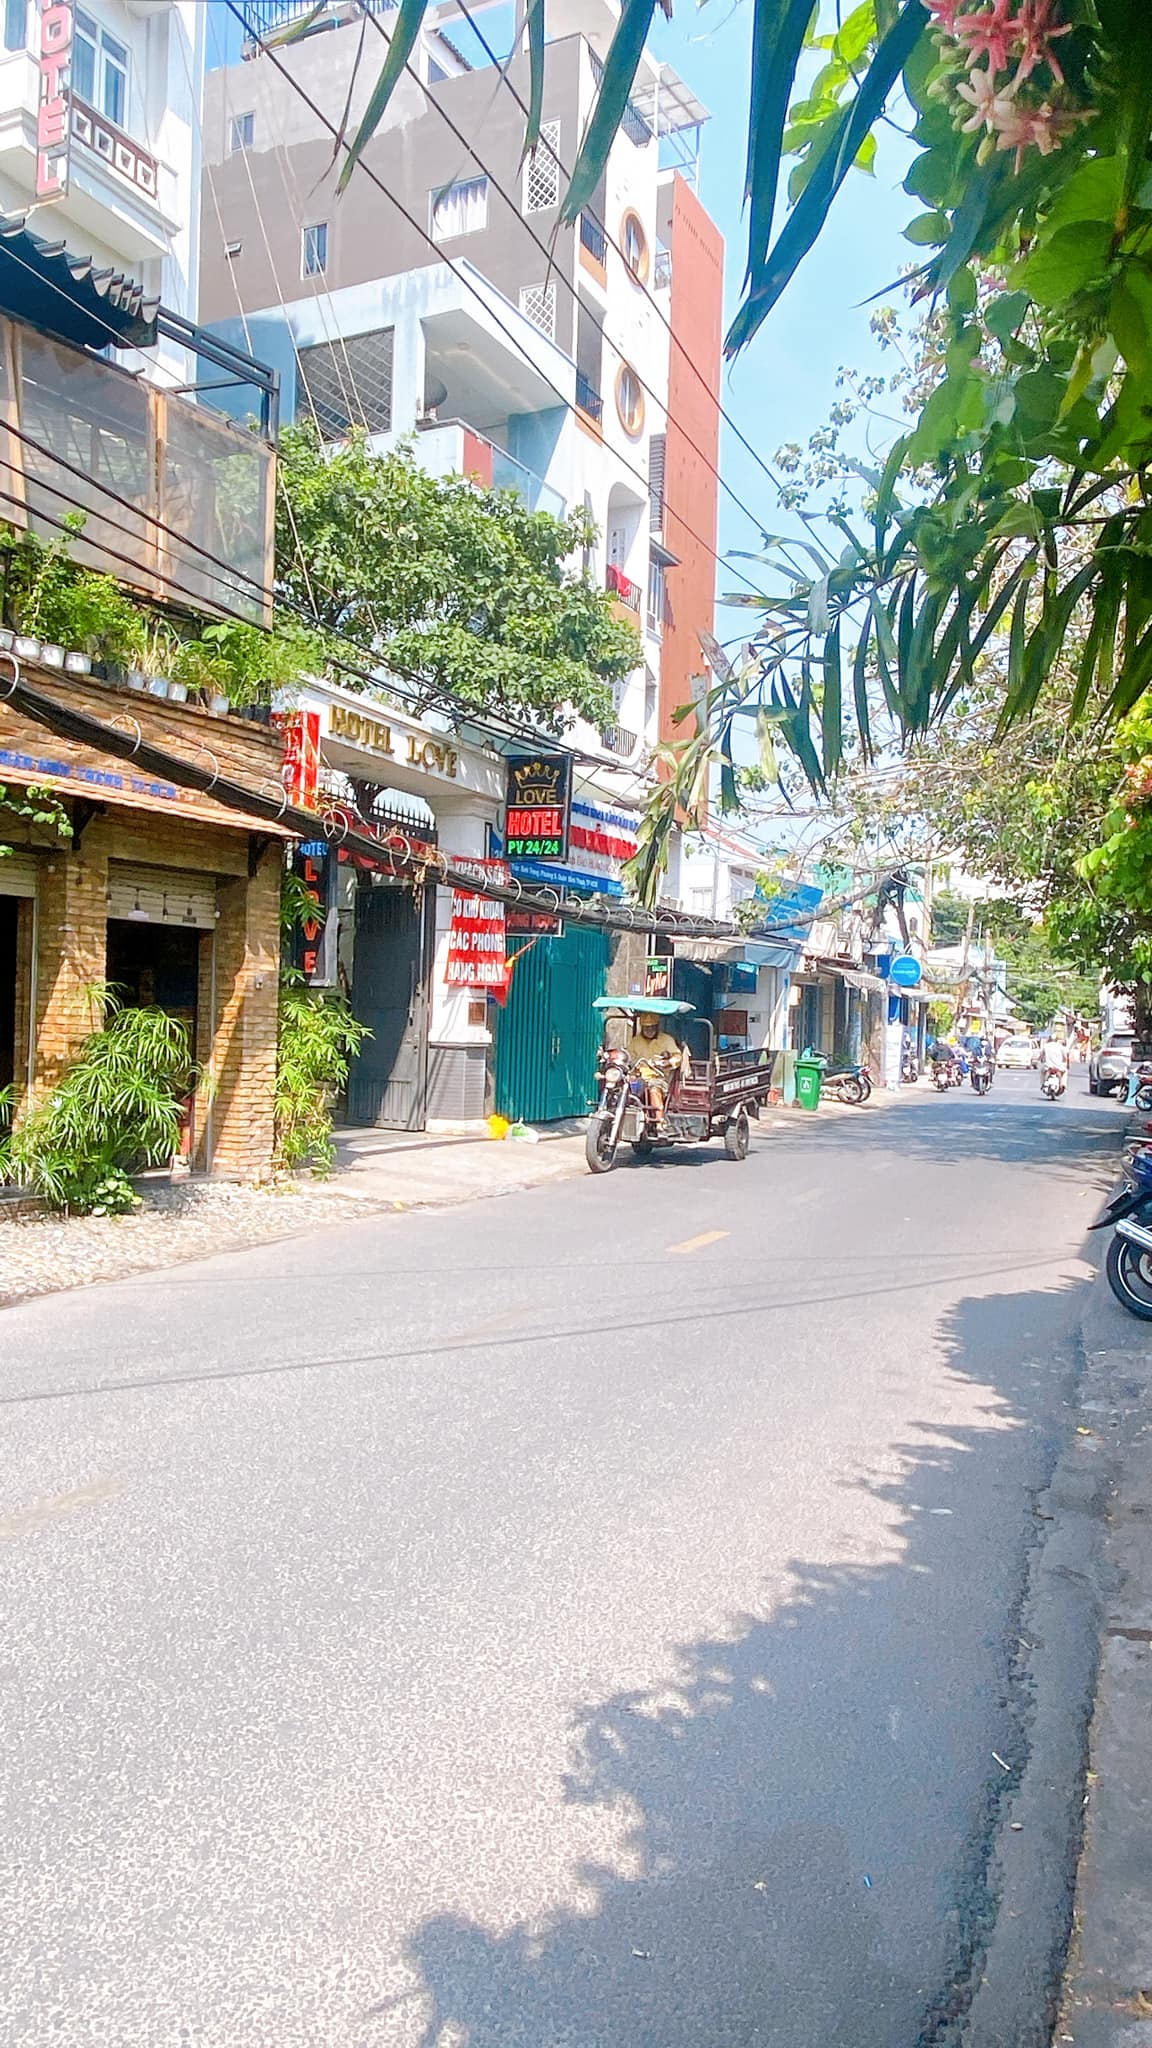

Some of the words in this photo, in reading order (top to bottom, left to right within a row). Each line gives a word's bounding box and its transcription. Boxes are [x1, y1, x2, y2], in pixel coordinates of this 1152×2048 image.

[37, 0, 73, 196] OTEL
[328, 704, 395, 755] HOTEL
[406, 734, 458, 778] LOVE
[515, 789, 557, 804] LOVE
[507, 811, 562, 836] HOTEL
[507, 840, 524, 854] PV
[525, 840, 559, 855] 24/24
[450, 928, 470, 951] CÁC
[471, 929, 504, 952] PHÒNG
[448, 958, 475, 981] HÀNG
[477, 959, 504, 982] NGÀY
